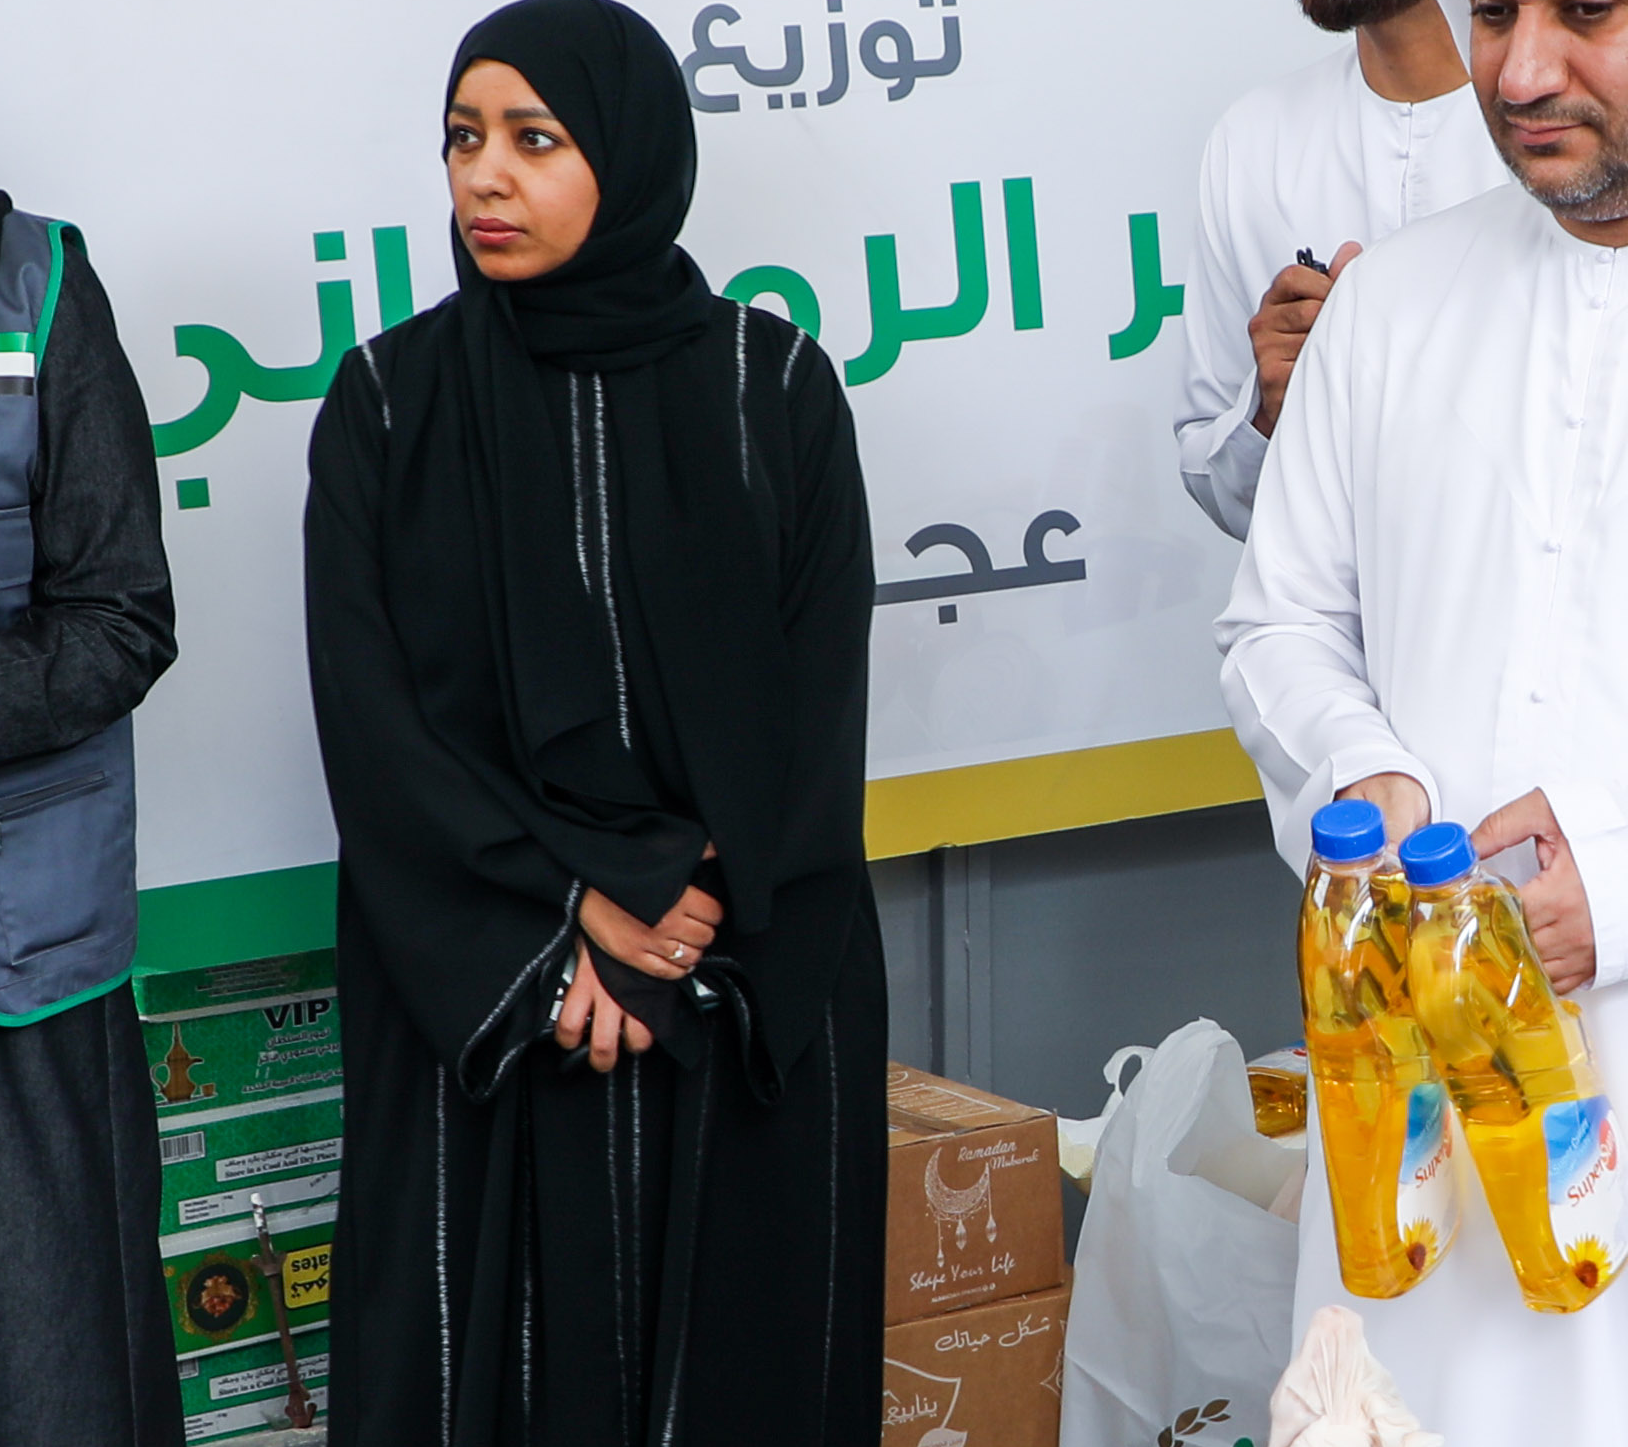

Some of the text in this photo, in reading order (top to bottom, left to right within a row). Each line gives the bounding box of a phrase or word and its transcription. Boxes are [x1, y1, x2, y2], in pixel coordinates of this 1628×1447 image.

[263, 999, 331, 1030] VIP
[957, 1140, 1016, 1163] Ramadan
[990, 1149, 1039, 1171] Mubarak
[291, 1253, 330, 1273] ates
[910, 1252, 1016, 1292] Shape Your Life
[998, 1314, 1051, 1348] شكل
